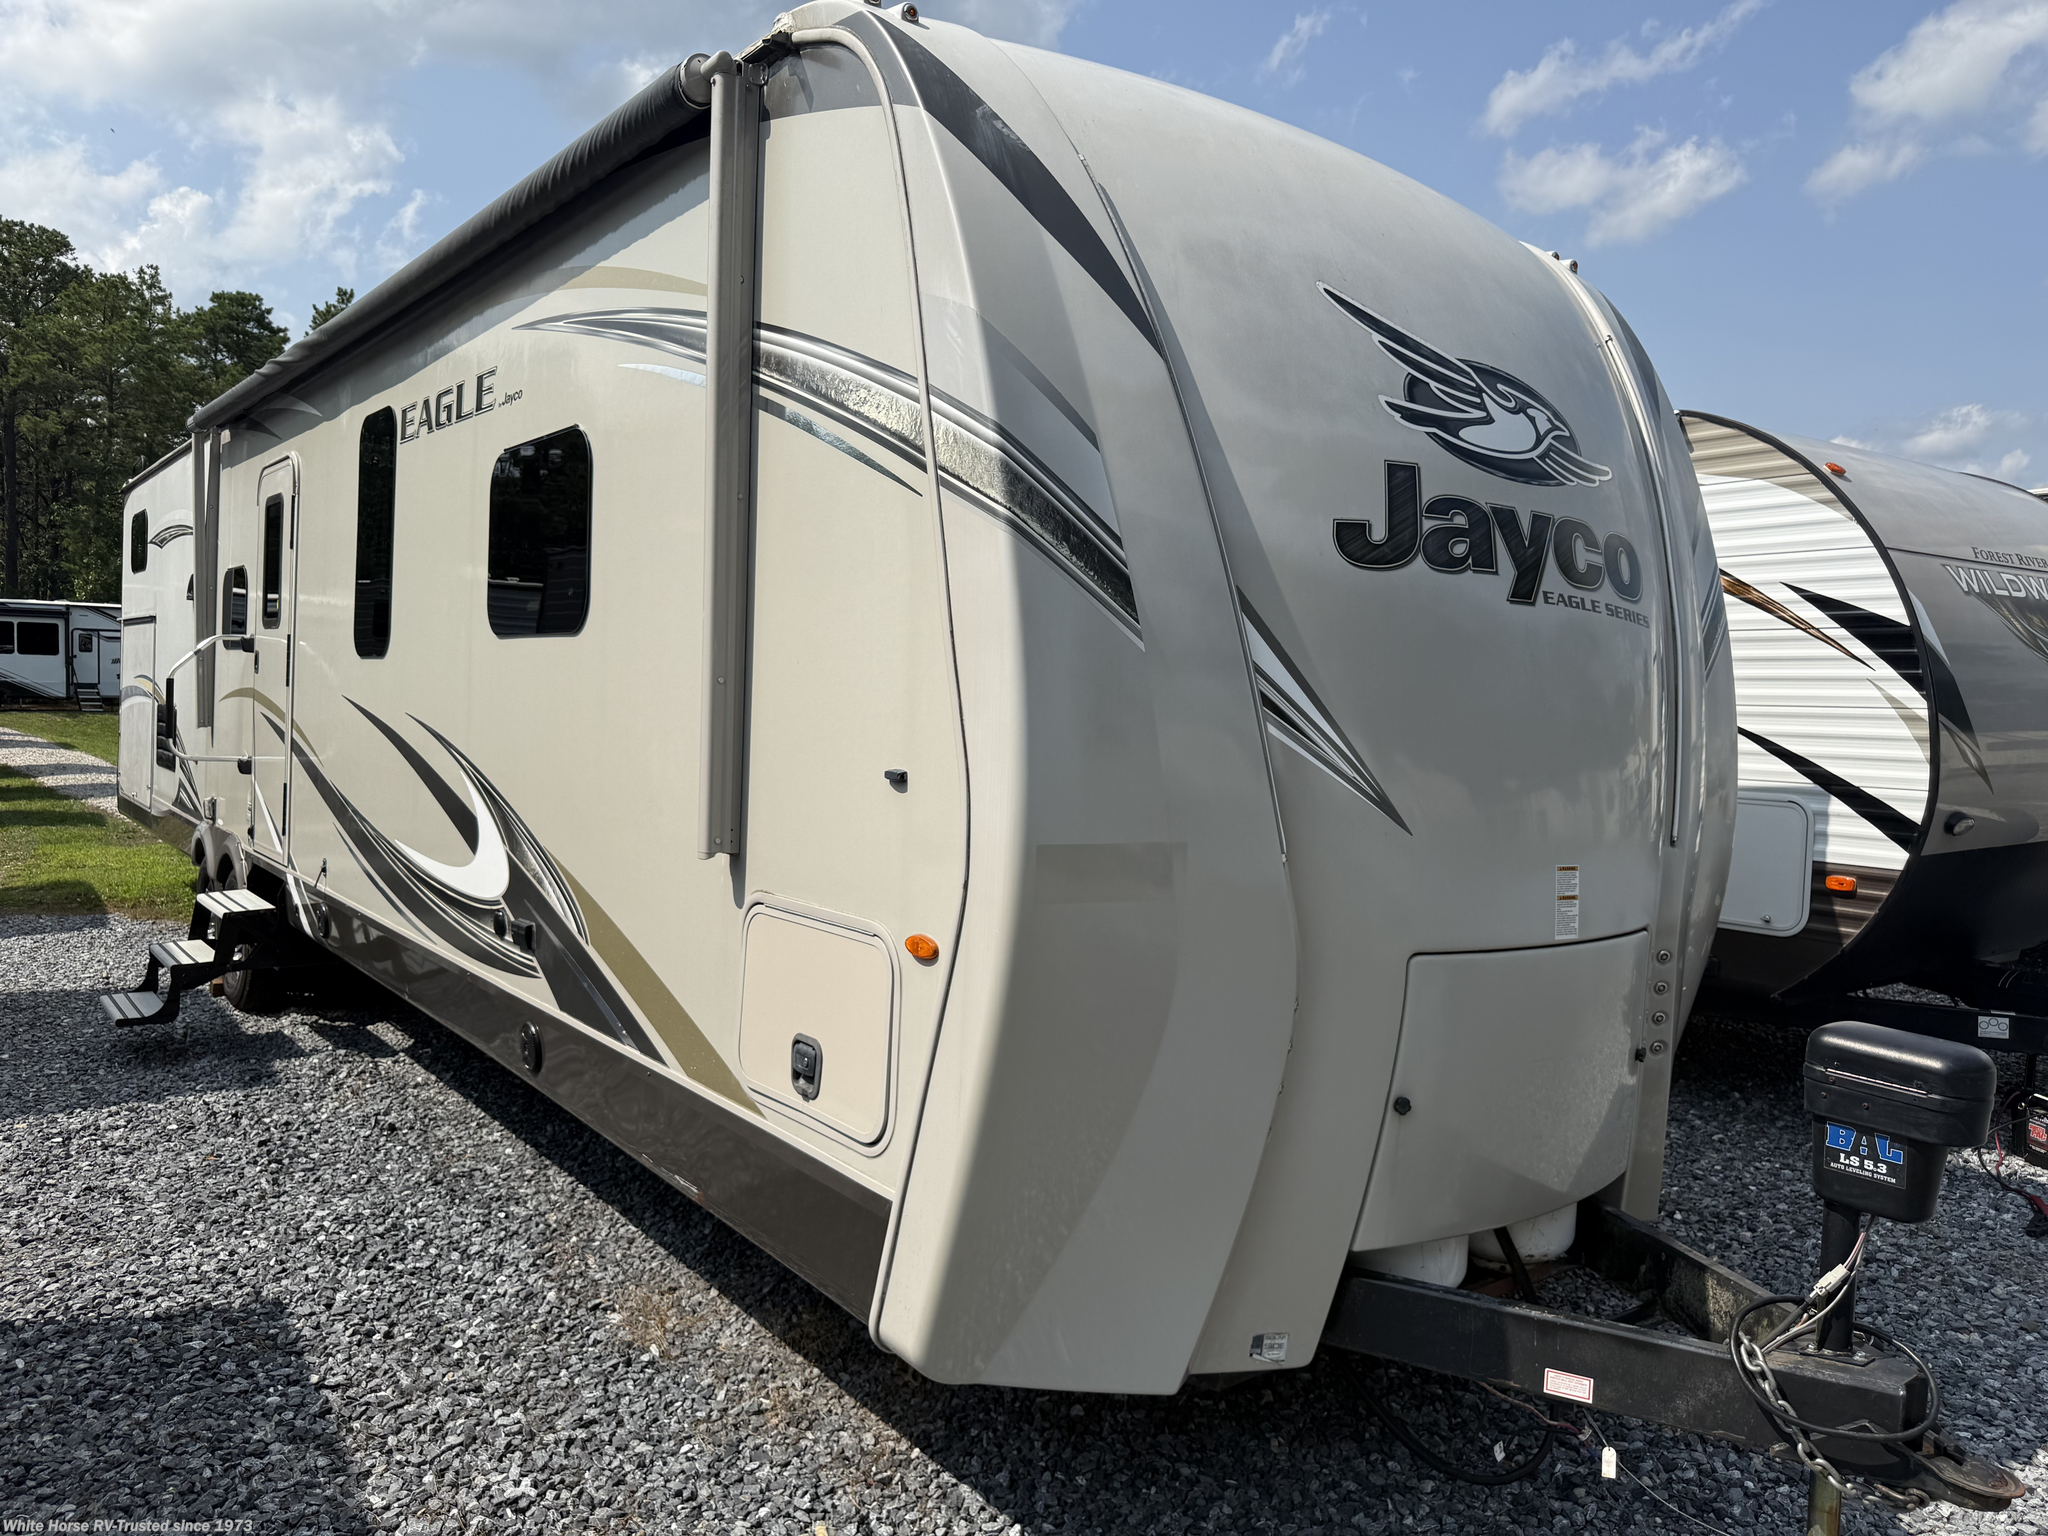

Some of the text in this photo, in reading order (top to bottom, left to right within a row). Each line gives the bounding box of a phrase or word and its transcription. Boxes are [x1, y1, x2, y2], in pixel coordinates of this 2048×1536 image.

[400, 366, 497, 444] EAGLE
[505, 389, 523, 406] Jayco
[1332, 459, 1643, 606] Jayco
[1971, 546, 2048, 569] FOREST RIVER
[1942, 564, 2048, 601] WILDW
[1542, 590, 1650, 629] EAGLE SERIES
[1830, 1162, 1896, 1184] AUTO LEVELING SYSTEM
[1839, 1152, 1887, 1174] LS 5.3
